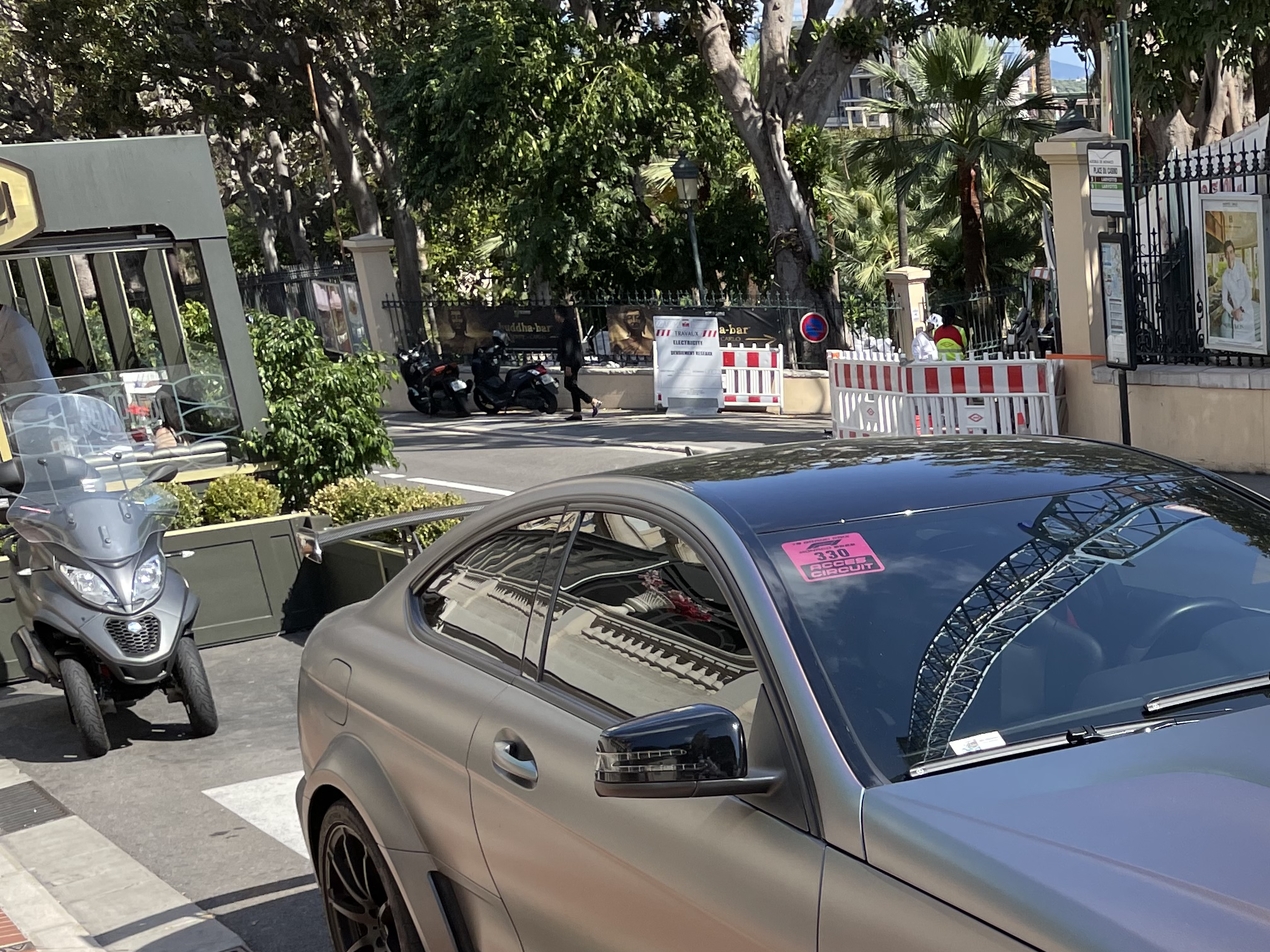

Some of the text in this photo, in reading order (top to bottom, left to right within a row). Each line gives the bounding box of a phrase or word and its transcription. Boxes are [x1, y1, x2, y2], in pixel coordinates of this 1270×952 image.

[813, 548, 850, 561] 330
[809, 556, 867, 571] ACCES
[811, 562, 874, 578] CIRCUIT
